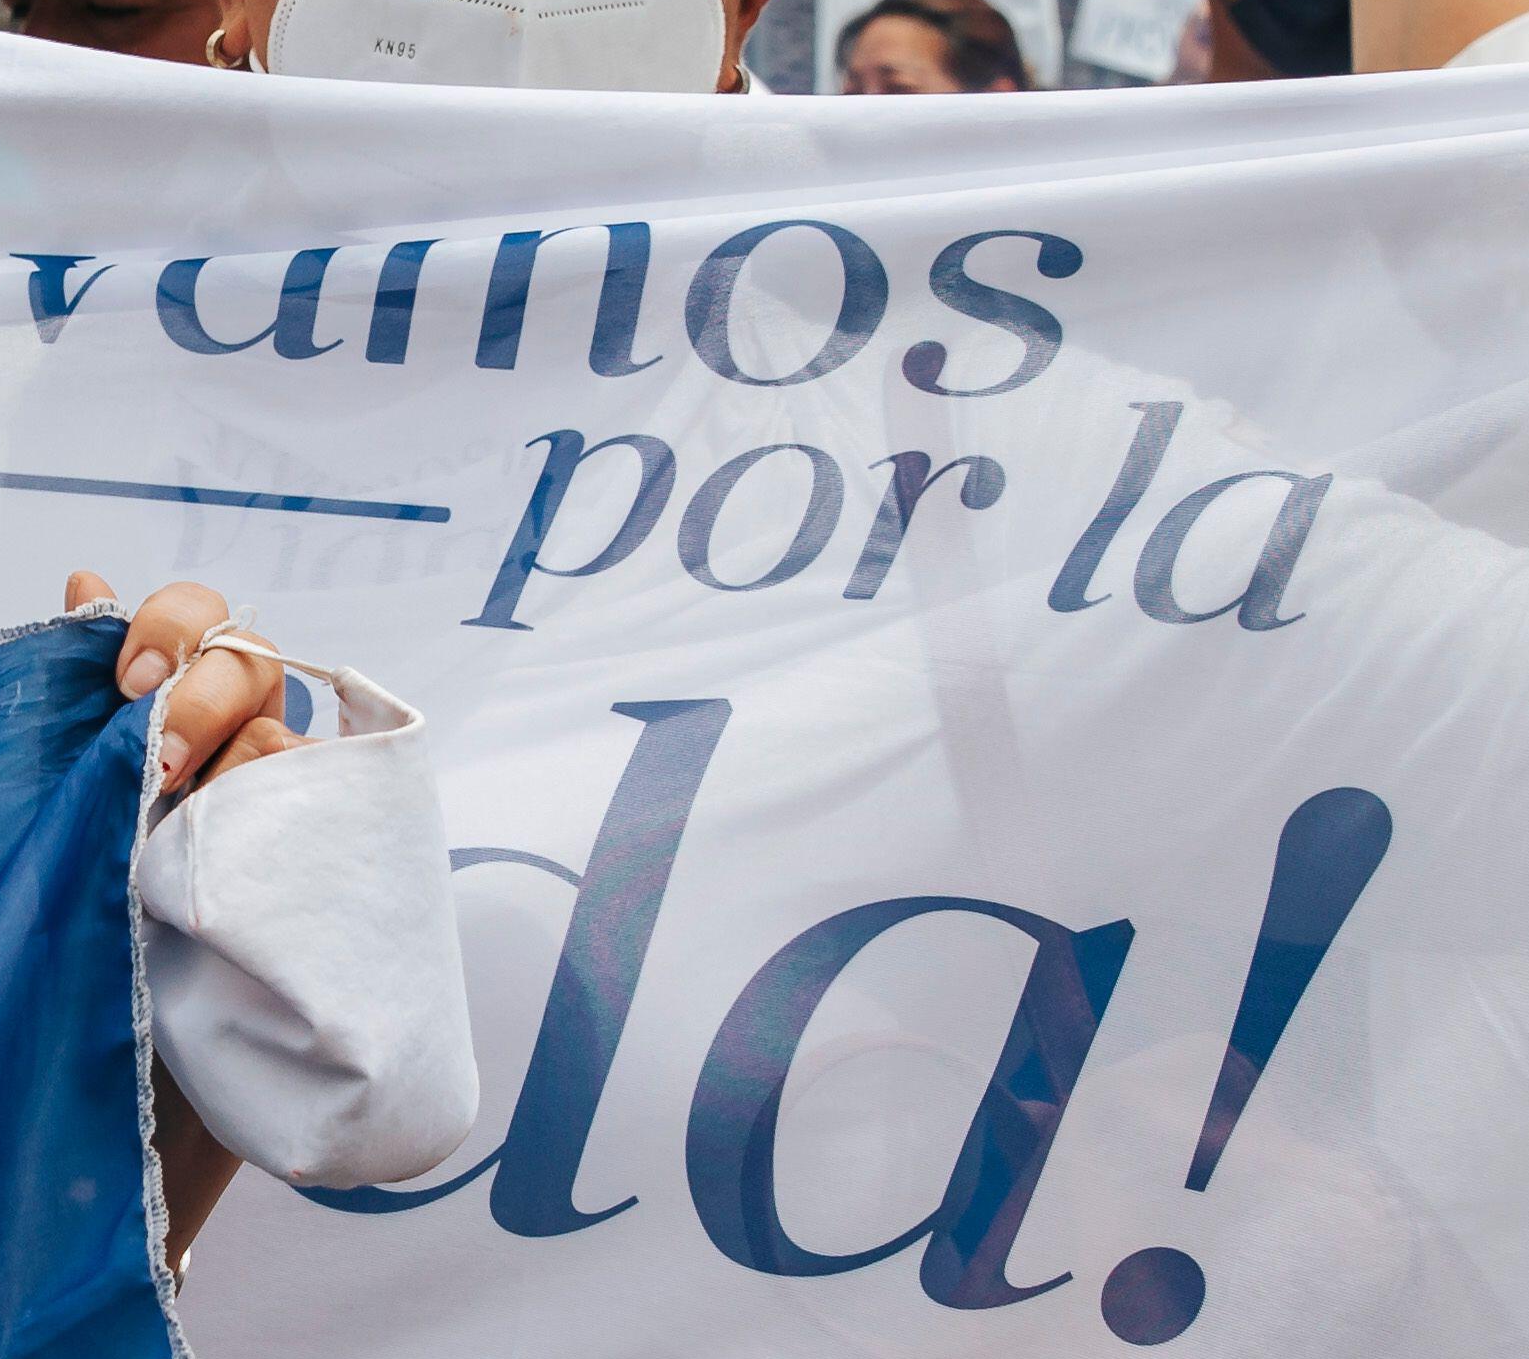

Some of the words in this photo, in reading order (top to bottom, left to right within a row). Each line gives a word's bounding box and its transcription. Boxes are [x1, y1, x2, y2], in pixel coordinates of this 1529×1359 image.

[373, 37, 416, 60] KN95
[460, 428, 1007, 633] por
[1045, 399, 1334, 633] la
[285, 697, 1393, 1348] da!
